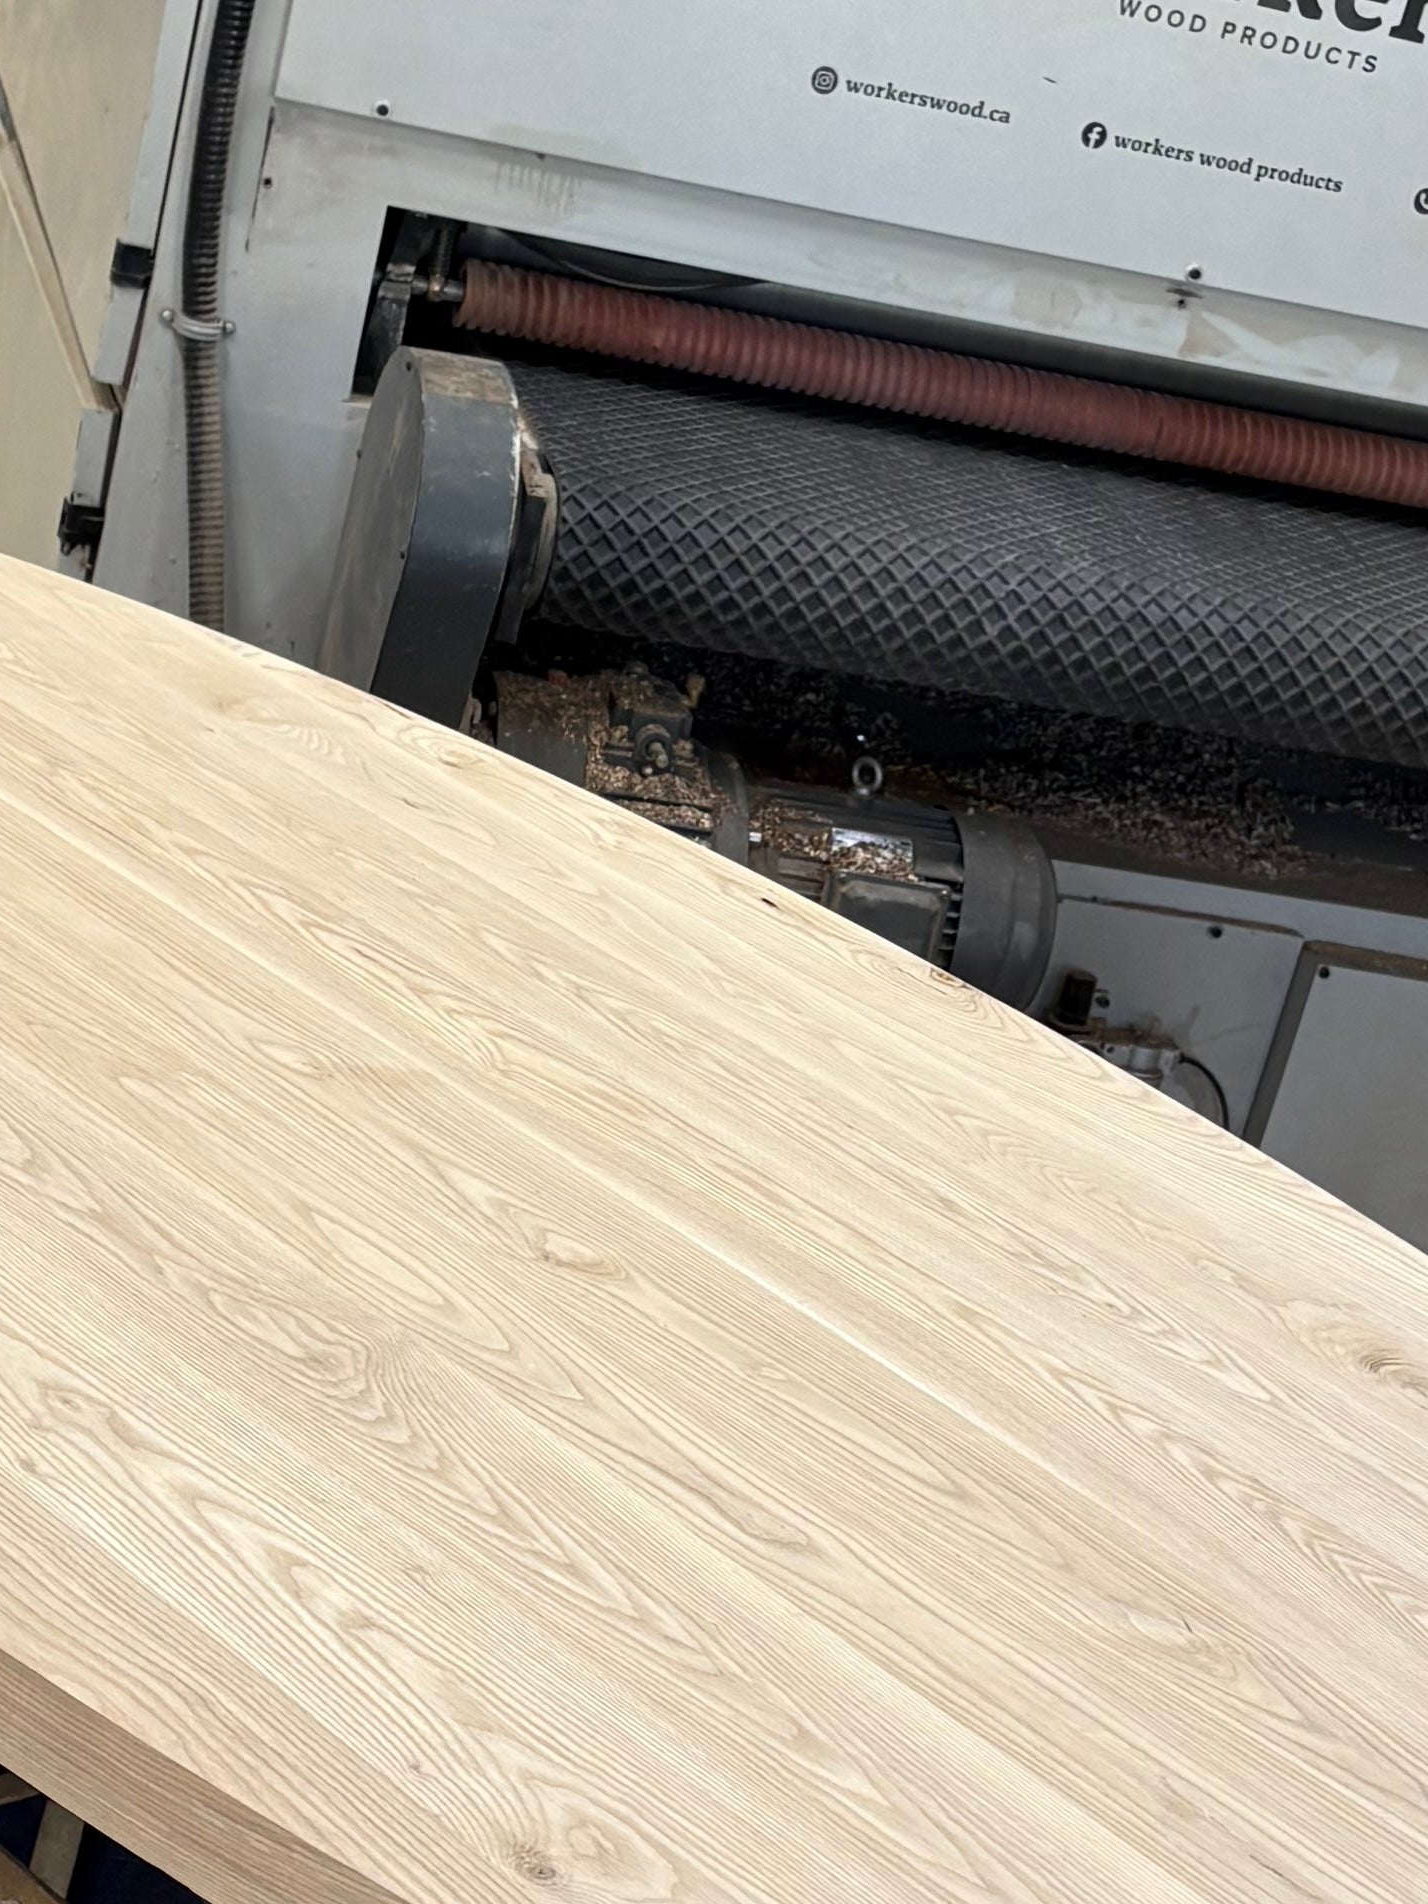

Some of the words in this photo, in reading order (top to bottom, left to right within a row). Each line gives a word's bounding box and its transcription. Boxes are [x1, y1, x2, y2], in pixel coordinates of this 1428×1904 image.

[1219, 21, 1379, 74] PRODUCTS
[845, 78, 1012, 125] workerswood.ca
[1113, 133, 1195, 163] workers
[1198, 151, 1254, 176] wood
[1253, 162, 1344, 194] products
